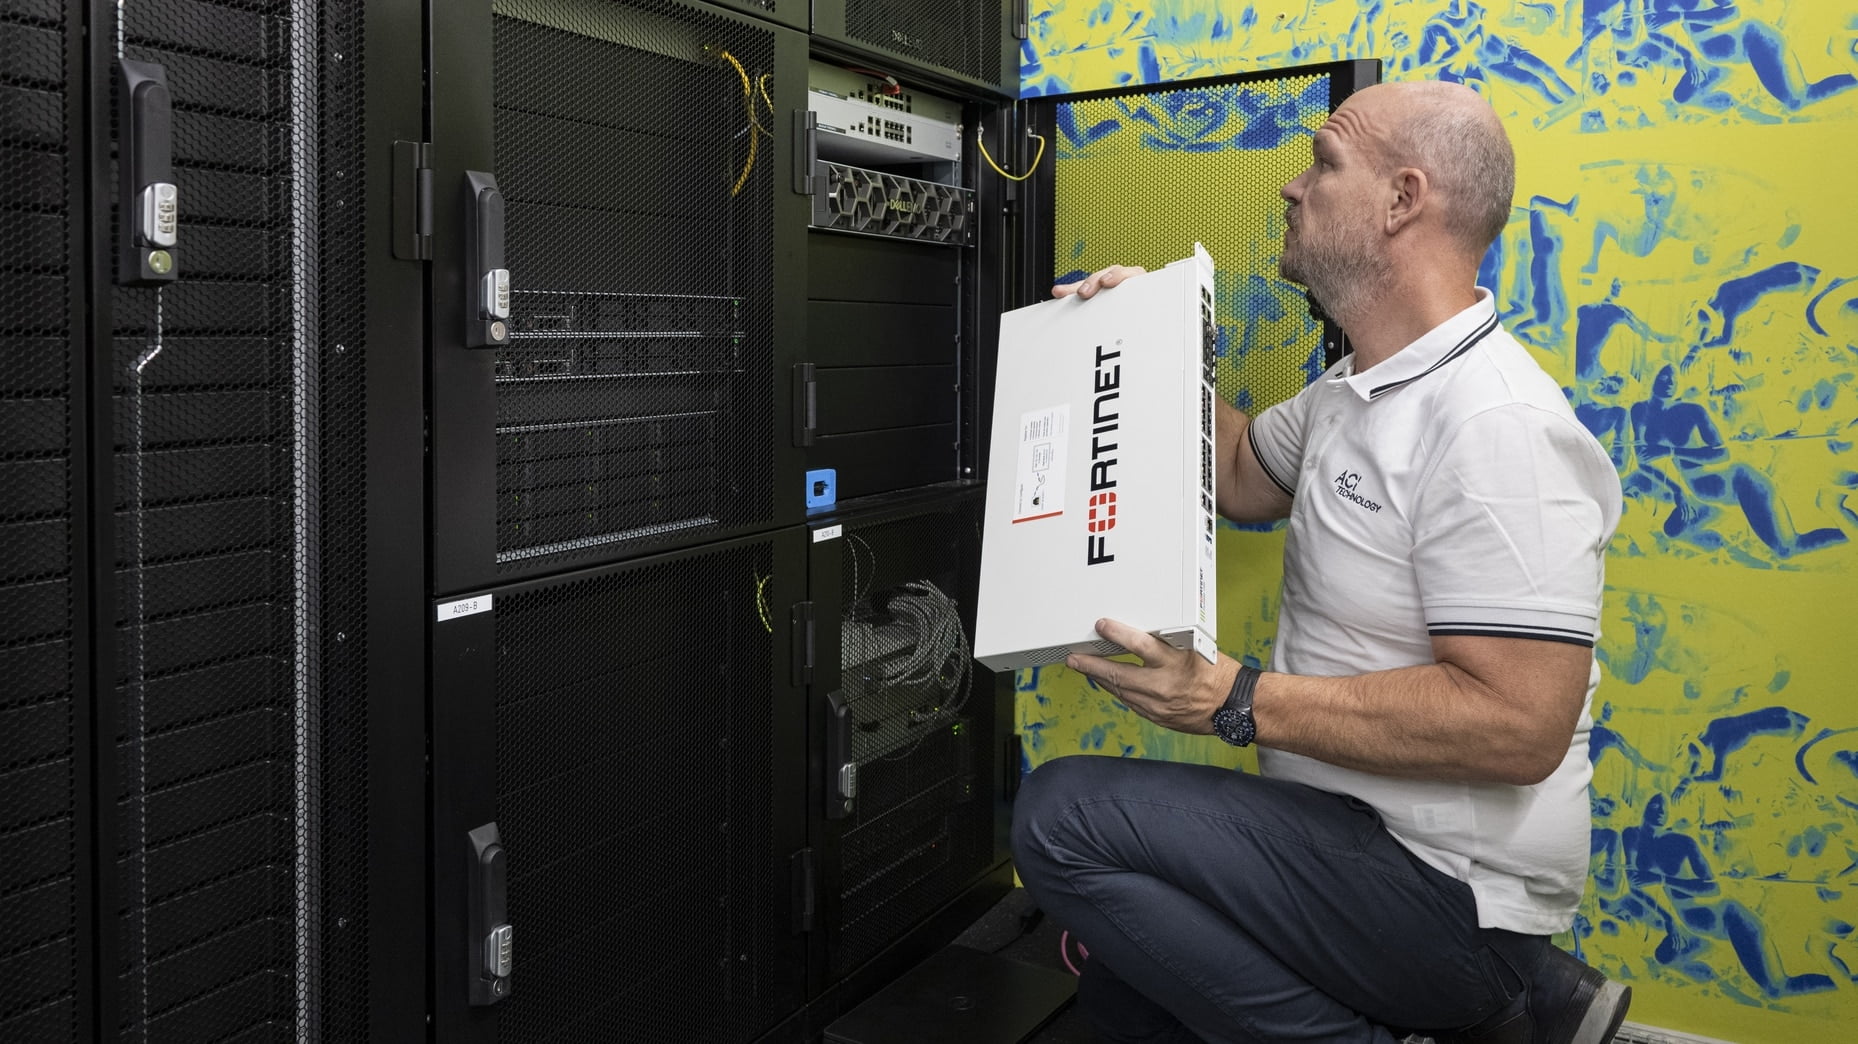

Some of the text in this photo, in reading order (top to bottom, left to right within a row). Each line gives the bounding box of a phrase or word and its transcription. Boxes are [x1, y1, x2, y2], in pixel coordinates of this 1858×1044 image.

[1088, 345, 1121, 566] FORTINET
[1335, 485, 1382, 513] TECHNOLOGY
[453, 601, 478, 614] A209-B
